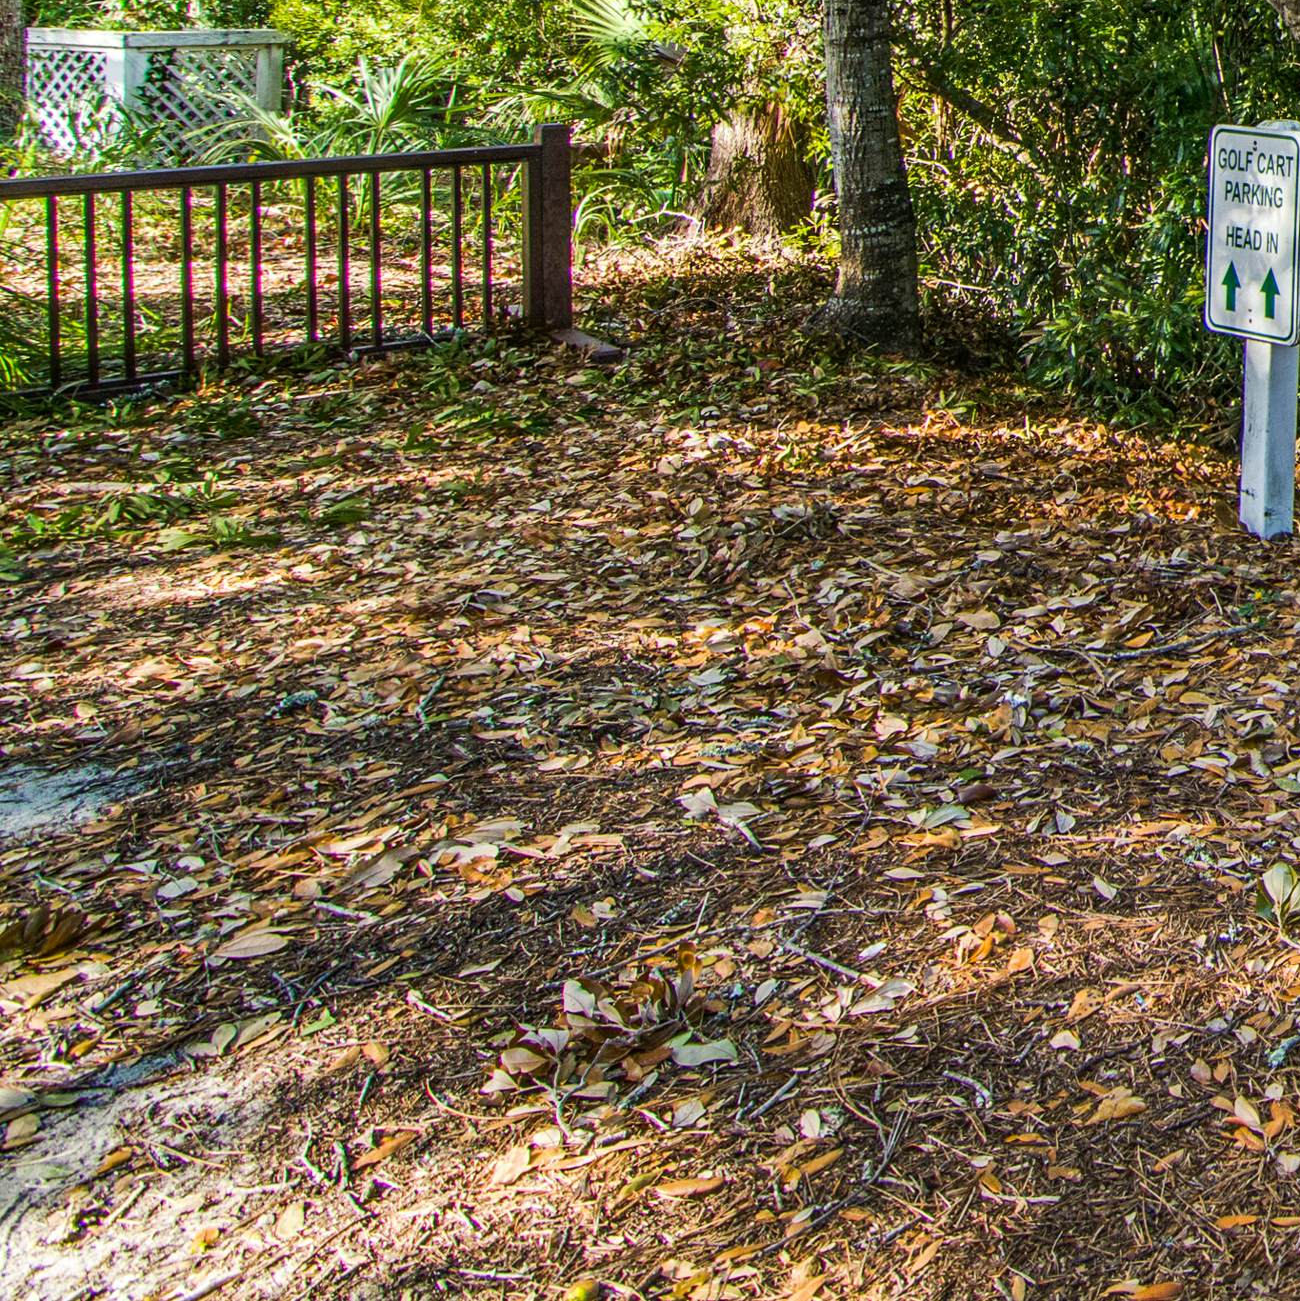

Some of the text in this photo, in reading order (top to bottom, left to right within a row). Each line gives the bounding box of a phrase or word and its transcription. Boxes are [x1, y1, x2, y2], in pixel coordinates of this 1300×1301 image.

[1218, 148, 1294, 178] GOLF CART
[1225, 180, 1283, 208] PARKING
[1226, 226, 1279, 254] HEAD IN
